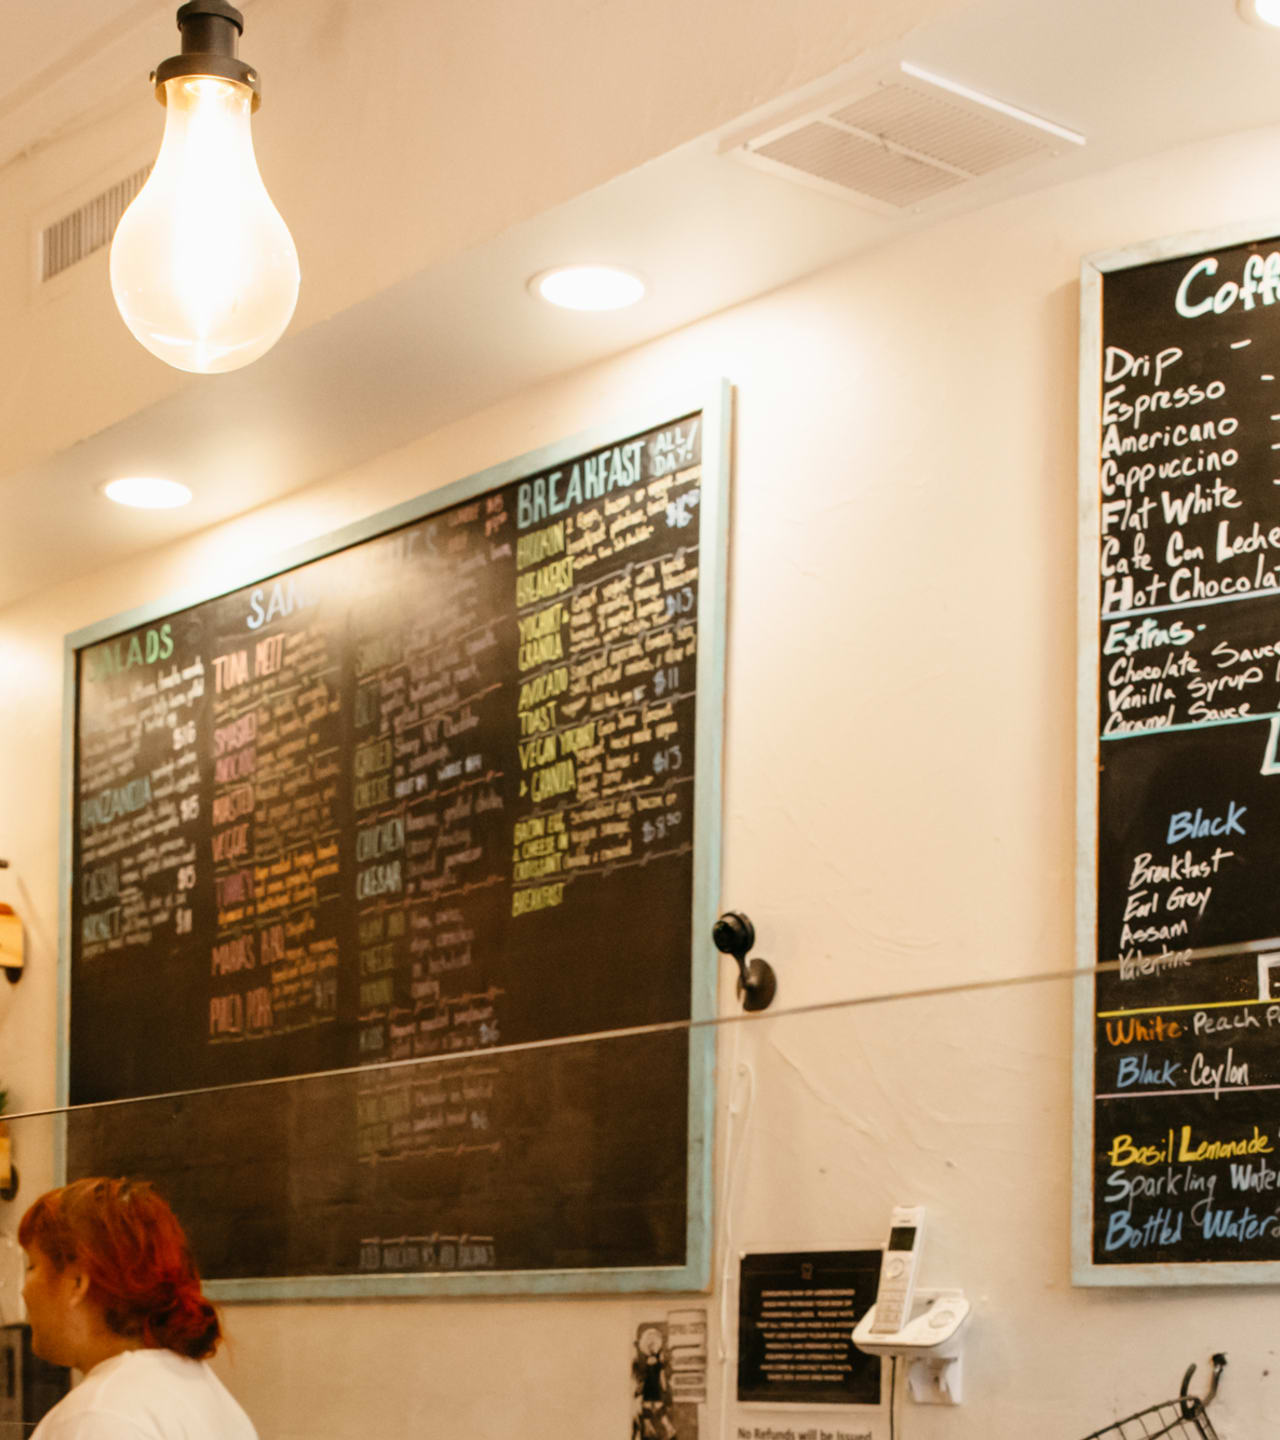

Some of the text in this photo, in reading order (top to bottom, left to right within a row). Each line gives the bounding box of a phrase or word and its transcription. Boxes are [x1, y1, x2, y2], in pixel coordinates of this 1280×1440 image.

[1104, 346, 1183, 386] Drip
[1102, 381, 1226, 429] Espresso
[1102, 417, 1239, 458] Americano
[517, 441, 645, 529] BREAKFAST
[655, 427, 685, 456] ALL
[1100, 449, 1239, 497] Cappuccino
[1101, 478, 1243, 534] Flat White
[1102, 574, 1166, 615] Hot
[213, 632, 285, 693] TUNA MELT
[1108, 651, 1201, 687] Chocolate
[518, 701, 556, 735] TOAST
[1108, 683, 1176, 713] Vanilla
[1167, 801, 1248, 845] Black
[1127, 848, 1235, 891] Breakfast
[1166, 886, 1212, 922] Grey
[1118, 919, 1188, 949] Assam
[1193, 1007, 1259, 1036] Peach
[1116, 1048, 1249, 1100] Black Ceylon
[1107, 1125, 1274, 1167] Basil Lemonade
[1202, 1209, 1278, 1241] Water
[738, 1428, 751, 1440] No
[754, 1428, 795, 1440] Refunds
